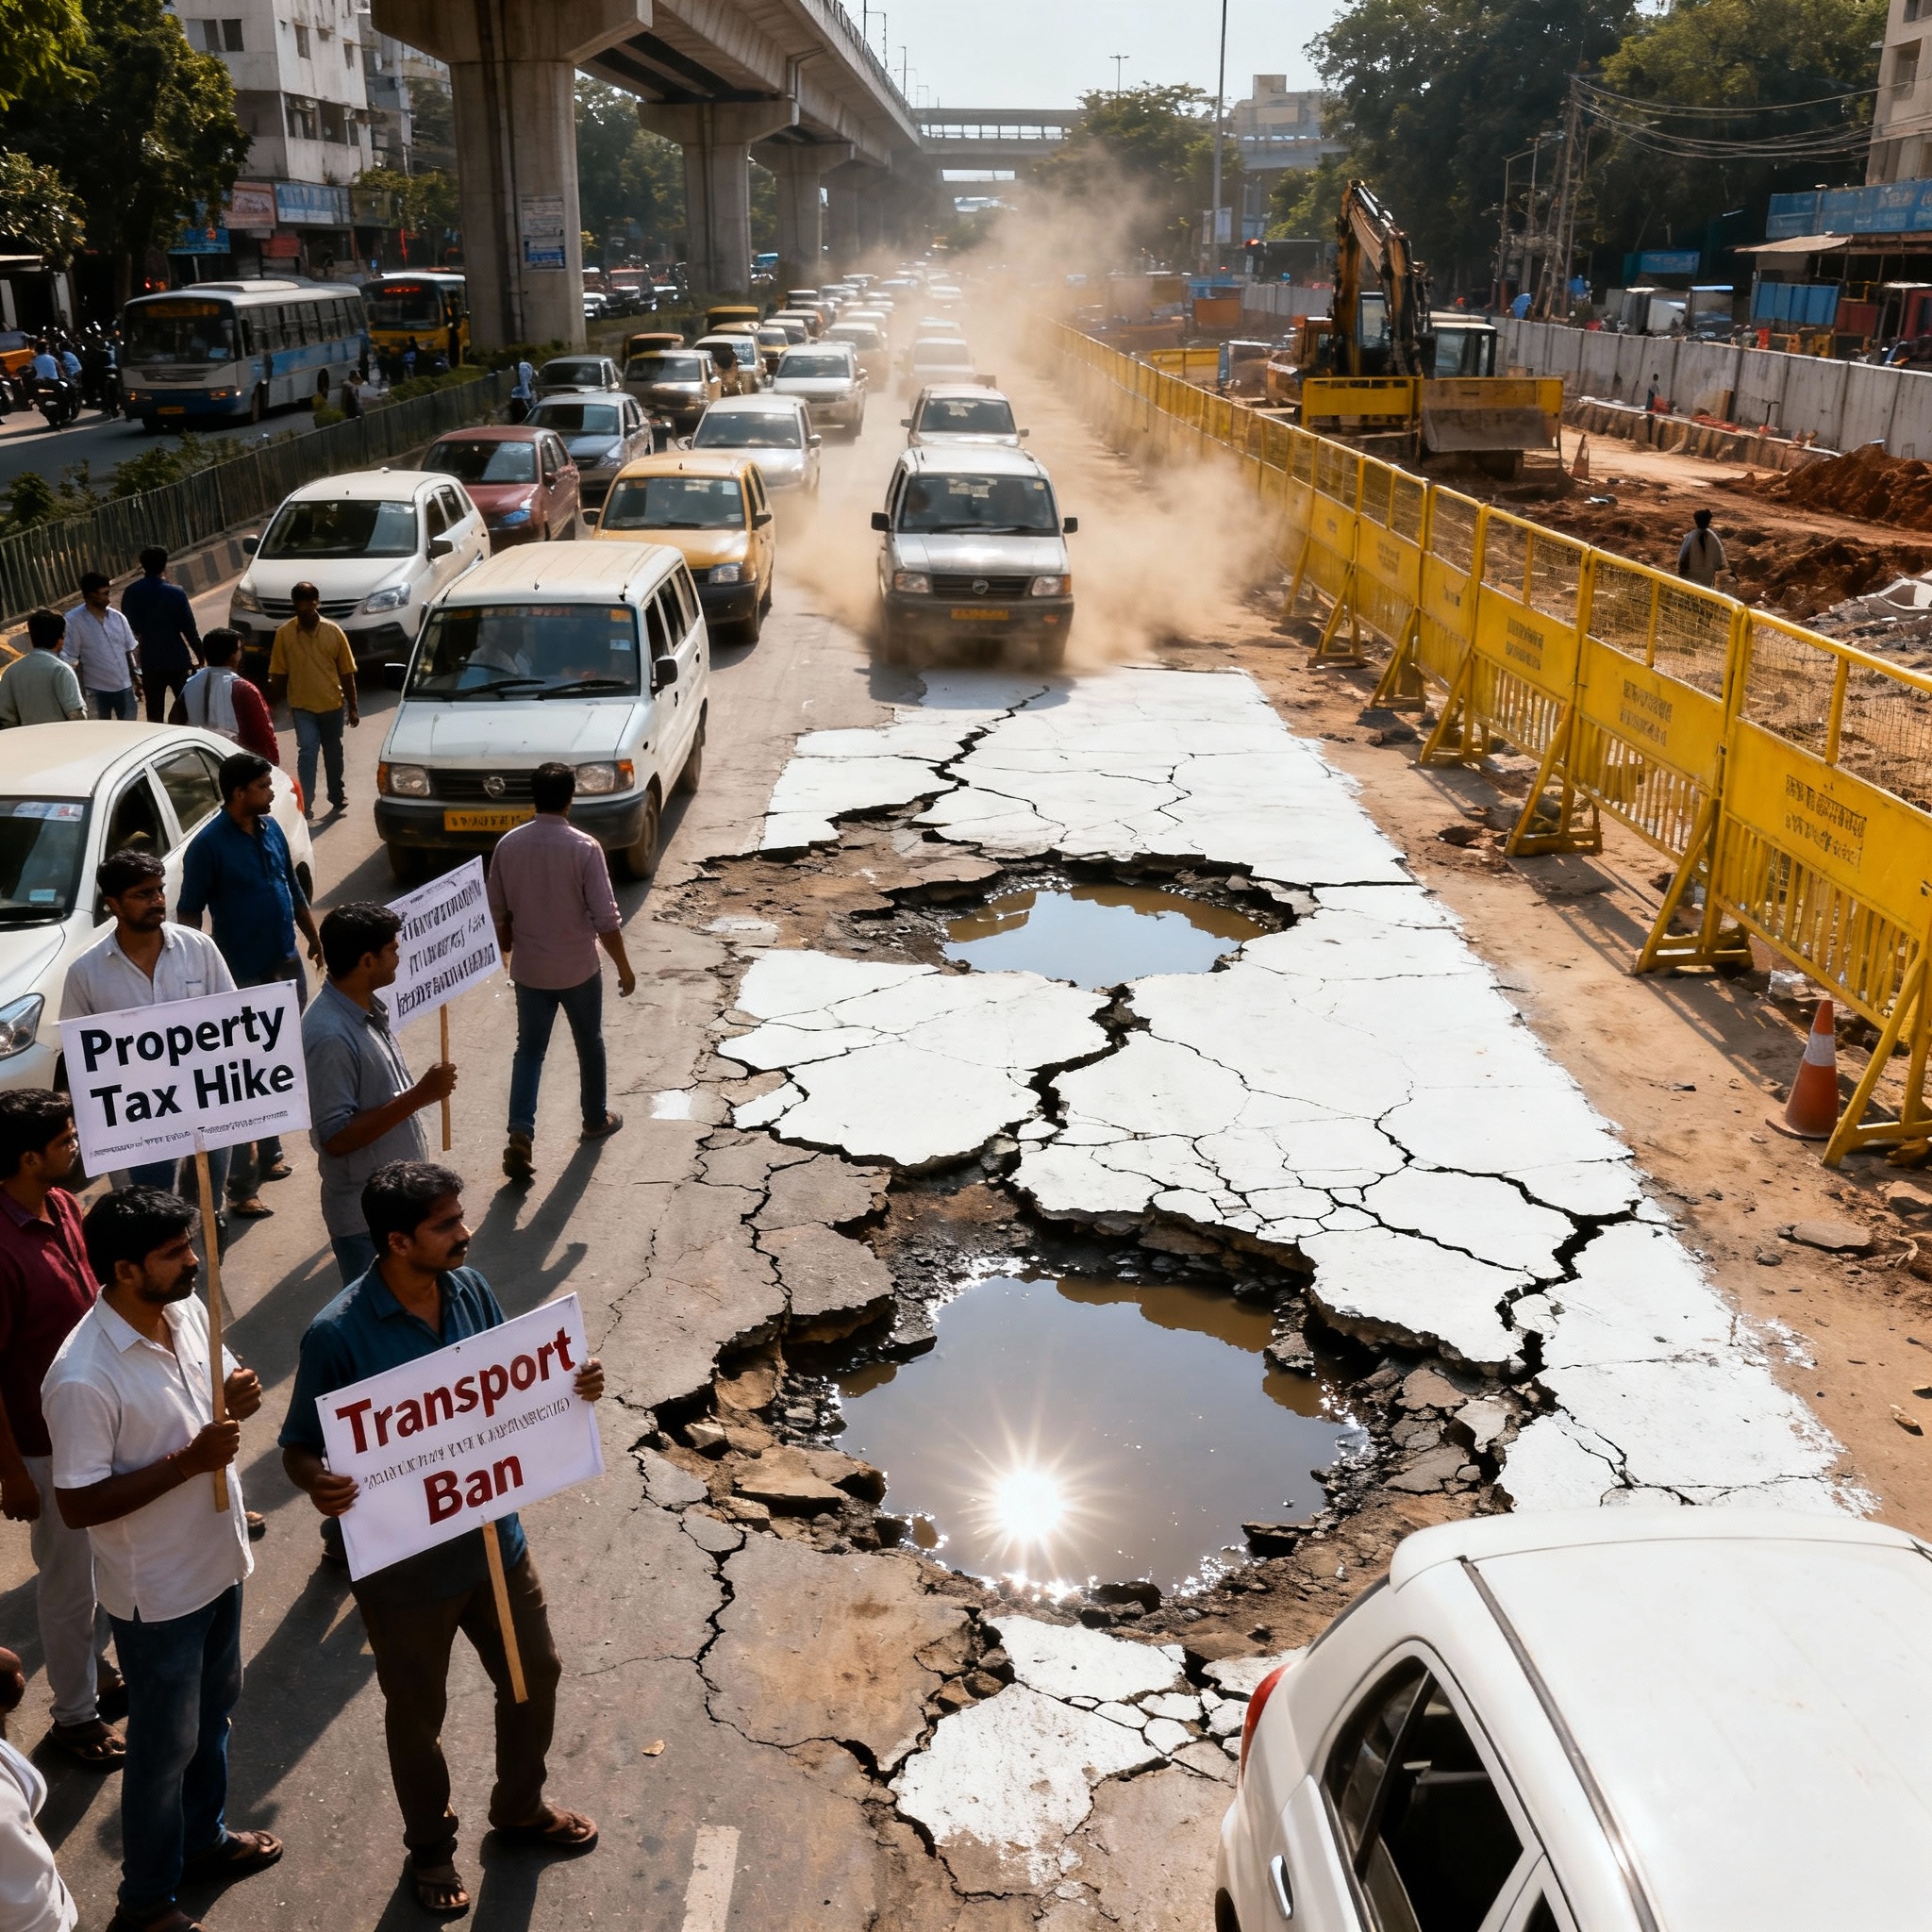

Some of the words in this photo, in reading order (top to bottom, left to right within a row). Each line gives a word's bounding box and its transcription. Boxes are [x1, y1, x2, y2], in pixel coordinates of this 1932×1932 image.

[79, 1006, 285, 1073] Property
[90, 1084, 183, 1127] Tax
[193, 1058, 295, 1109] Hike
[335, 1327, 575, 1454] Transport
[423, 1455, 524, 1525] Ban
